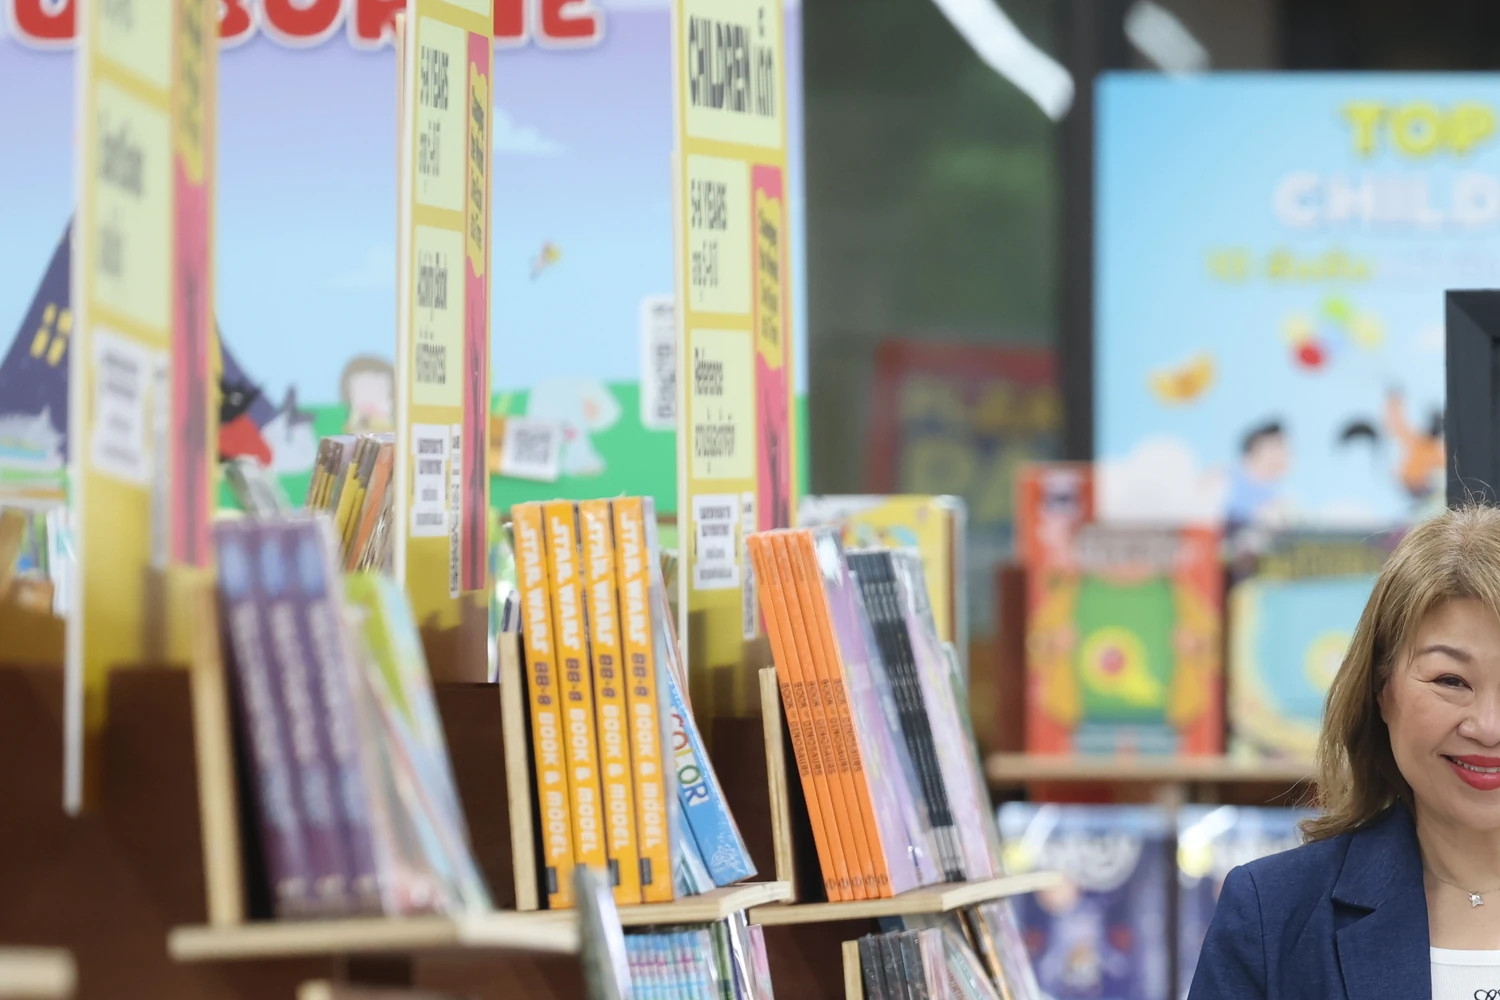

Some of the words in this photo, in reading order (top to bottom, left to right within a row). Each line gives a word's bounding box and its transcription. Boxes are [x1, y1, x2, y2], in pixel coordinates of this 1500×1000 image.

[688, 15, 752, 114] CHILDREN
[1342, 100, 1495, 159] TOP
[521, 519, 541, 587] STAR
[553, 516, 573, 583] STAR
[586, 513, 609, 580] STAR
[621, 512, 641, 578] STAR
[527, 590, 547, 652] WARS
[557, 585, 579, 649] WARS
[592, 582, 613, 646] WARS
[626, 581, 646, 645] WARS
[539, 712, 558, 764] BOOK
[570, 709, 588, 760] BOOK
[603, 705, 621, 757] BOOK
[635, 703, 654, 756] BOOK
[781, 682, 792, 709] BOOK
[791, 718, 809, 777] DINOSAURS
[794, 681, 807, 709] BOOK
[804, 719, 821, 777] DINOSAURS
[808, 680, 820, 708] BOOK
[816, 718, 835, 776] DINOSAURS
[820, 679, 833, 706] BOOK
[830, 717, 849, 774] DINOSAURS
[834, 678, 846, 705] BOOK
[843, 715, 862, 773] DINOSAURS
[547, 791, 567, 857] MODEL
[577, 787, 596, 853] MODEL
[608, 783, 629, 849] MODEL
[642, 782, 661, 847] MODEL
